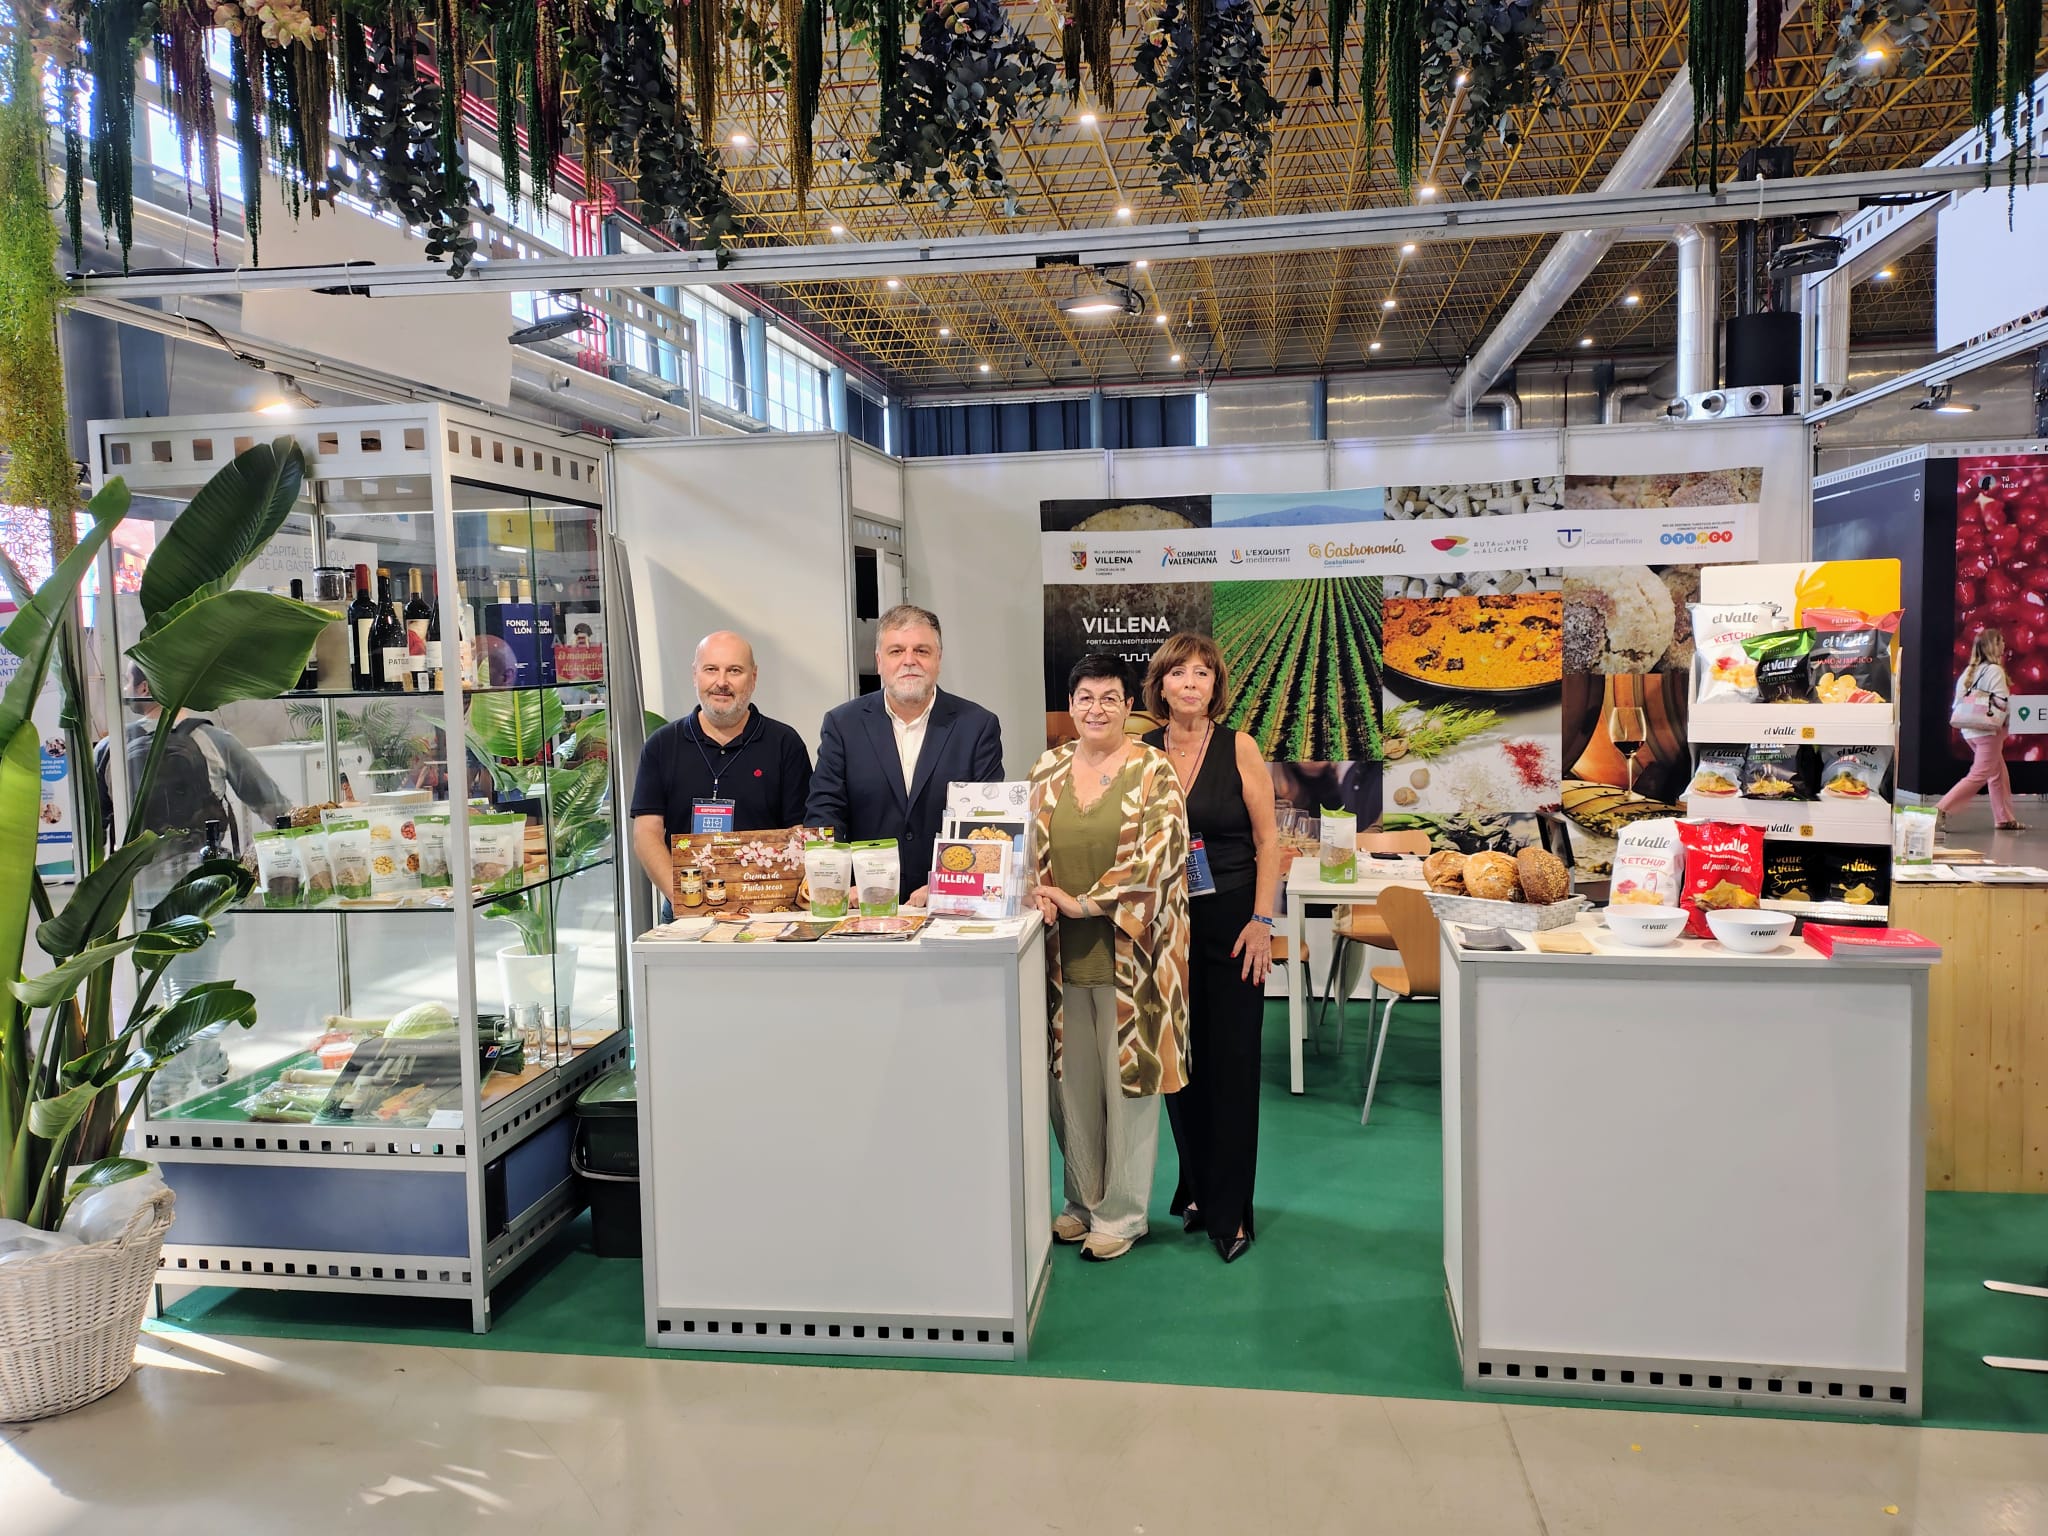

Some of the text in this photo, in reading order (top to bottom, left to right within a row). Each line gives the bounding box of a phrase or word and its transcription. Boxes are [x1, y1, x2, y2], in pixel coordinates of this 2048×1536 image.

[1506, 538, 1529, 546] VINO
[1245, 548, 1291, 556] L'EXQUISIT
[1324, 538, 1407, 559] Gastronomía
[1482, 545, 1528, 554] ALICANTE
[1177, 550, 1217, 558] COMUNITAT
[1094, 556, 1133, 564] VILLENA
[1168, 557, 1218, 566] VALENCIANA
[506, 619, 529, 627] FONDI
[1082, 616, 1171, 634] VILLENA
[514, 627, 532, 635] LLÓN
[1620, 857, 1667, 868] KETCHUP
[934, 873, 976, 885] VILLENA
